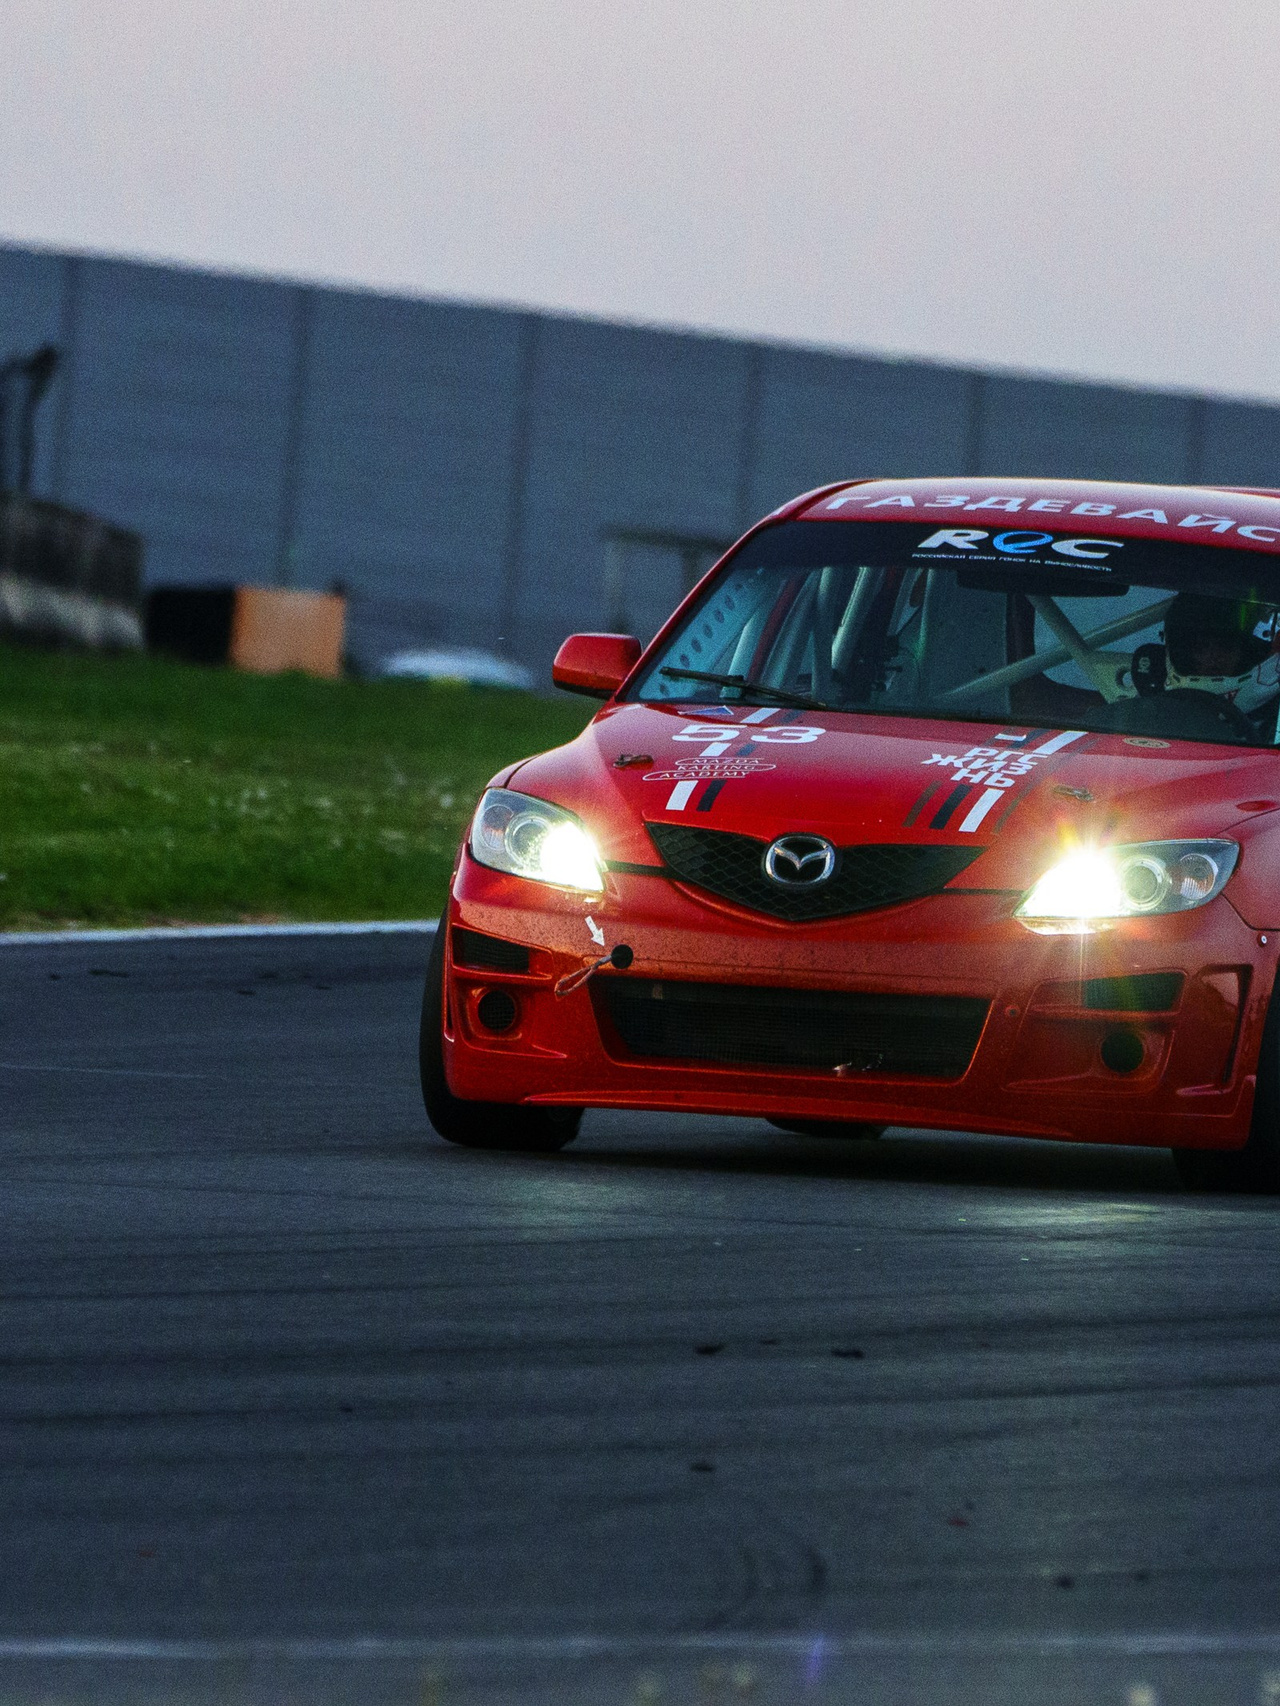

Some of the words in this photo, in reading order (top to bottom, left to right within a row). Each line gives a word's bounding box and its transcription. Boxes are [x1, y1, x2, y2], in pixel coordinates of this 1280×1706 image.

[672, 724, 827, 743] 53
[920, 753, 1034, 776] ЖИЗ
[964, 747, 1048, 766] РГС
[950, 768, 1016, 788] НЬ
